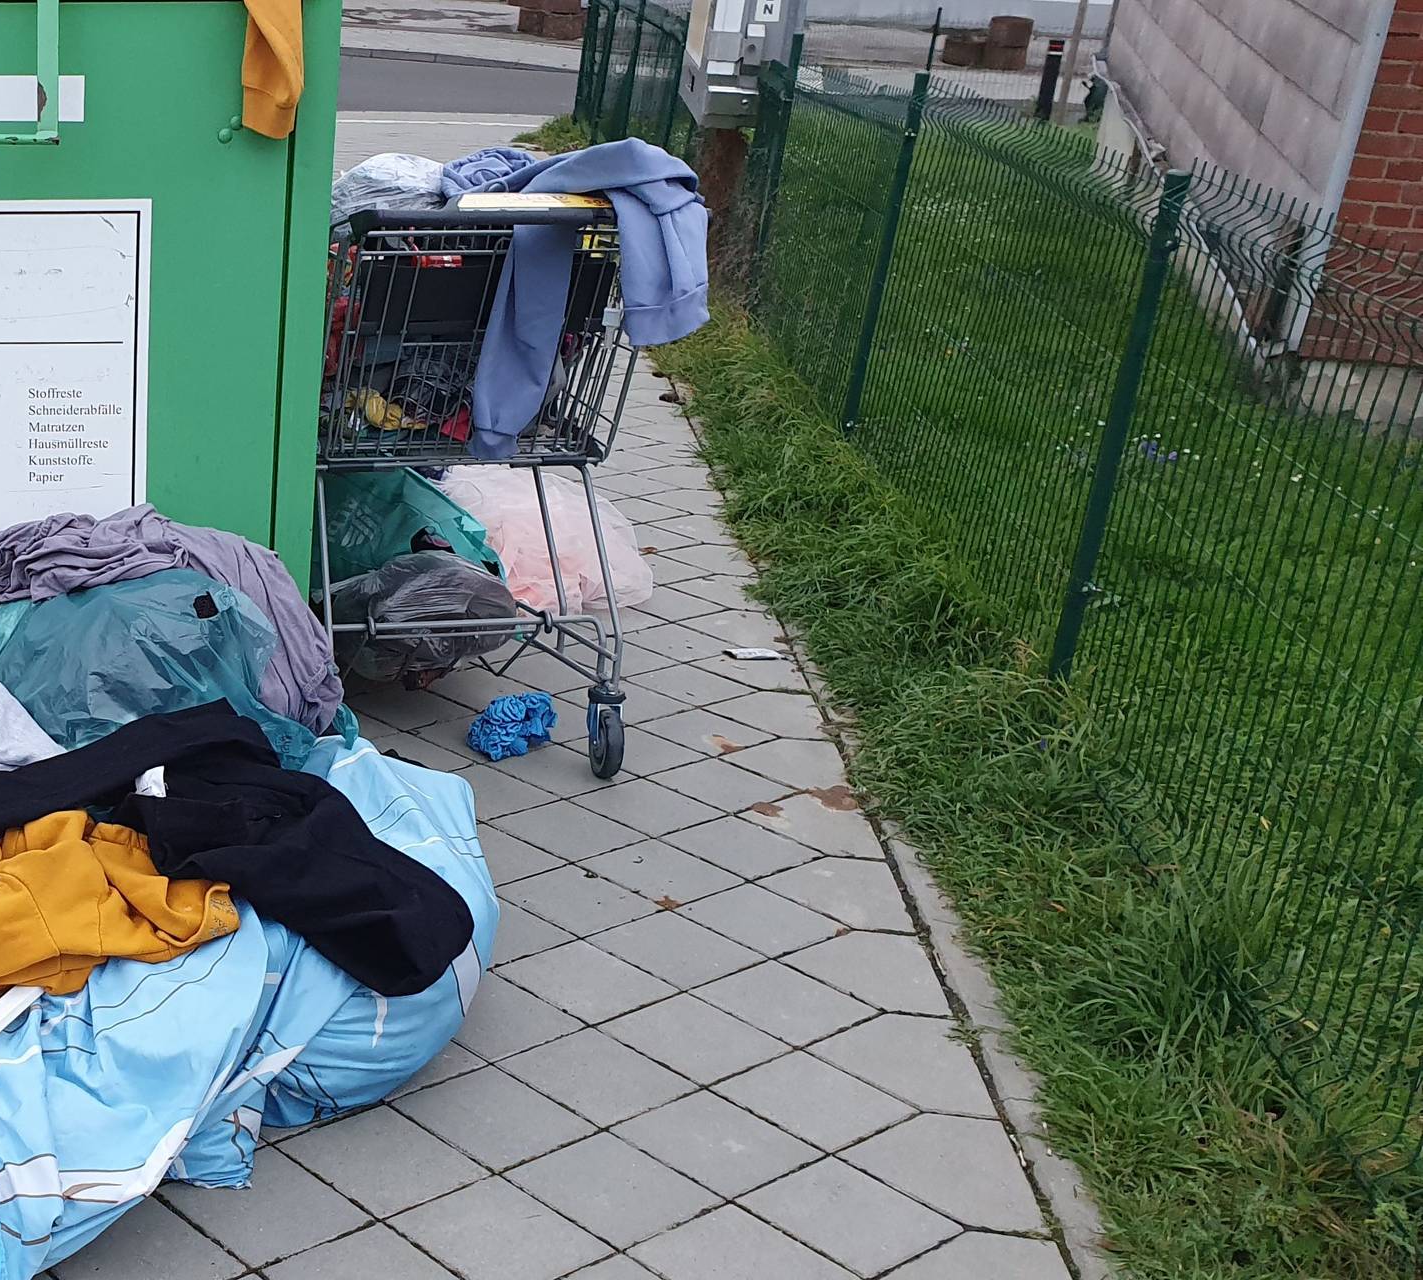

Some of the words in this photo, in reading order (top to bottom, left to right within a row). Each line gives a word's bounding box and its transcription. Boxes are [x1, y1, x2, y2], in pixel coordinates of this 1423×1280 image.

[28, 387, 83, 399] Stoffreste
[28, 404, 122, 416] Schneiderabfälle
[28, 421, 85, 433] Matratzen
[28, 437, 109, 449] Hausmüllreste
[28, 454, 93, 466] Kunststoffe
[28, 471, 65, 485] Papier
